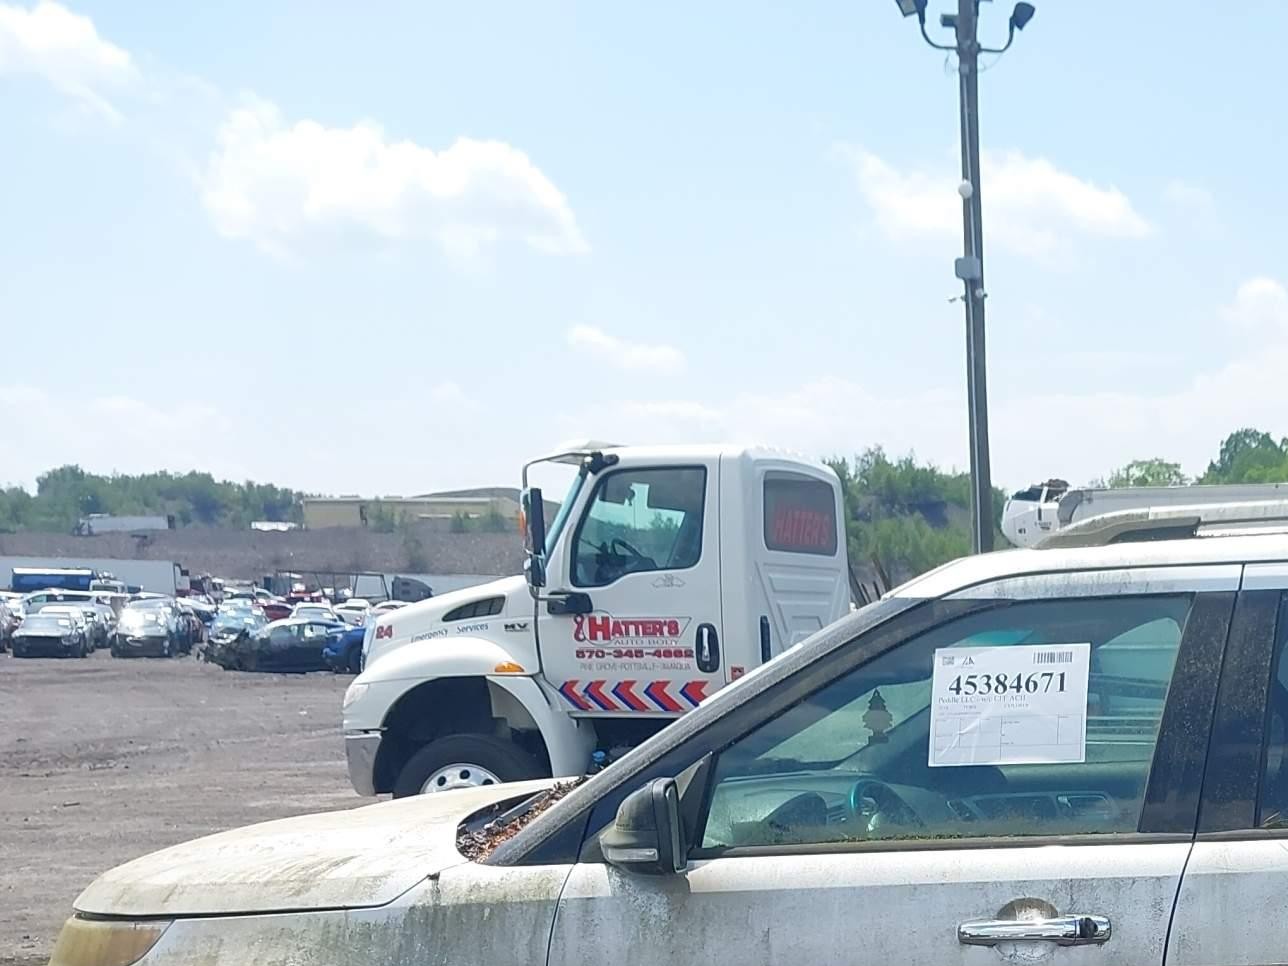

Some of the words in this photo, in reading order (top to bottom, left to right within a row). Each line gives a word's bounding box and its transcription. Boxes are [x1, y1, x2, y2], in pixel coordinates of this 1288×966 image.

[376, 625, 393, 639] 24
[456, 623, 489, 634] Services
[588, 616, 680, 641] HATTER'S
[949, 672, 1066, 696] 45384671
